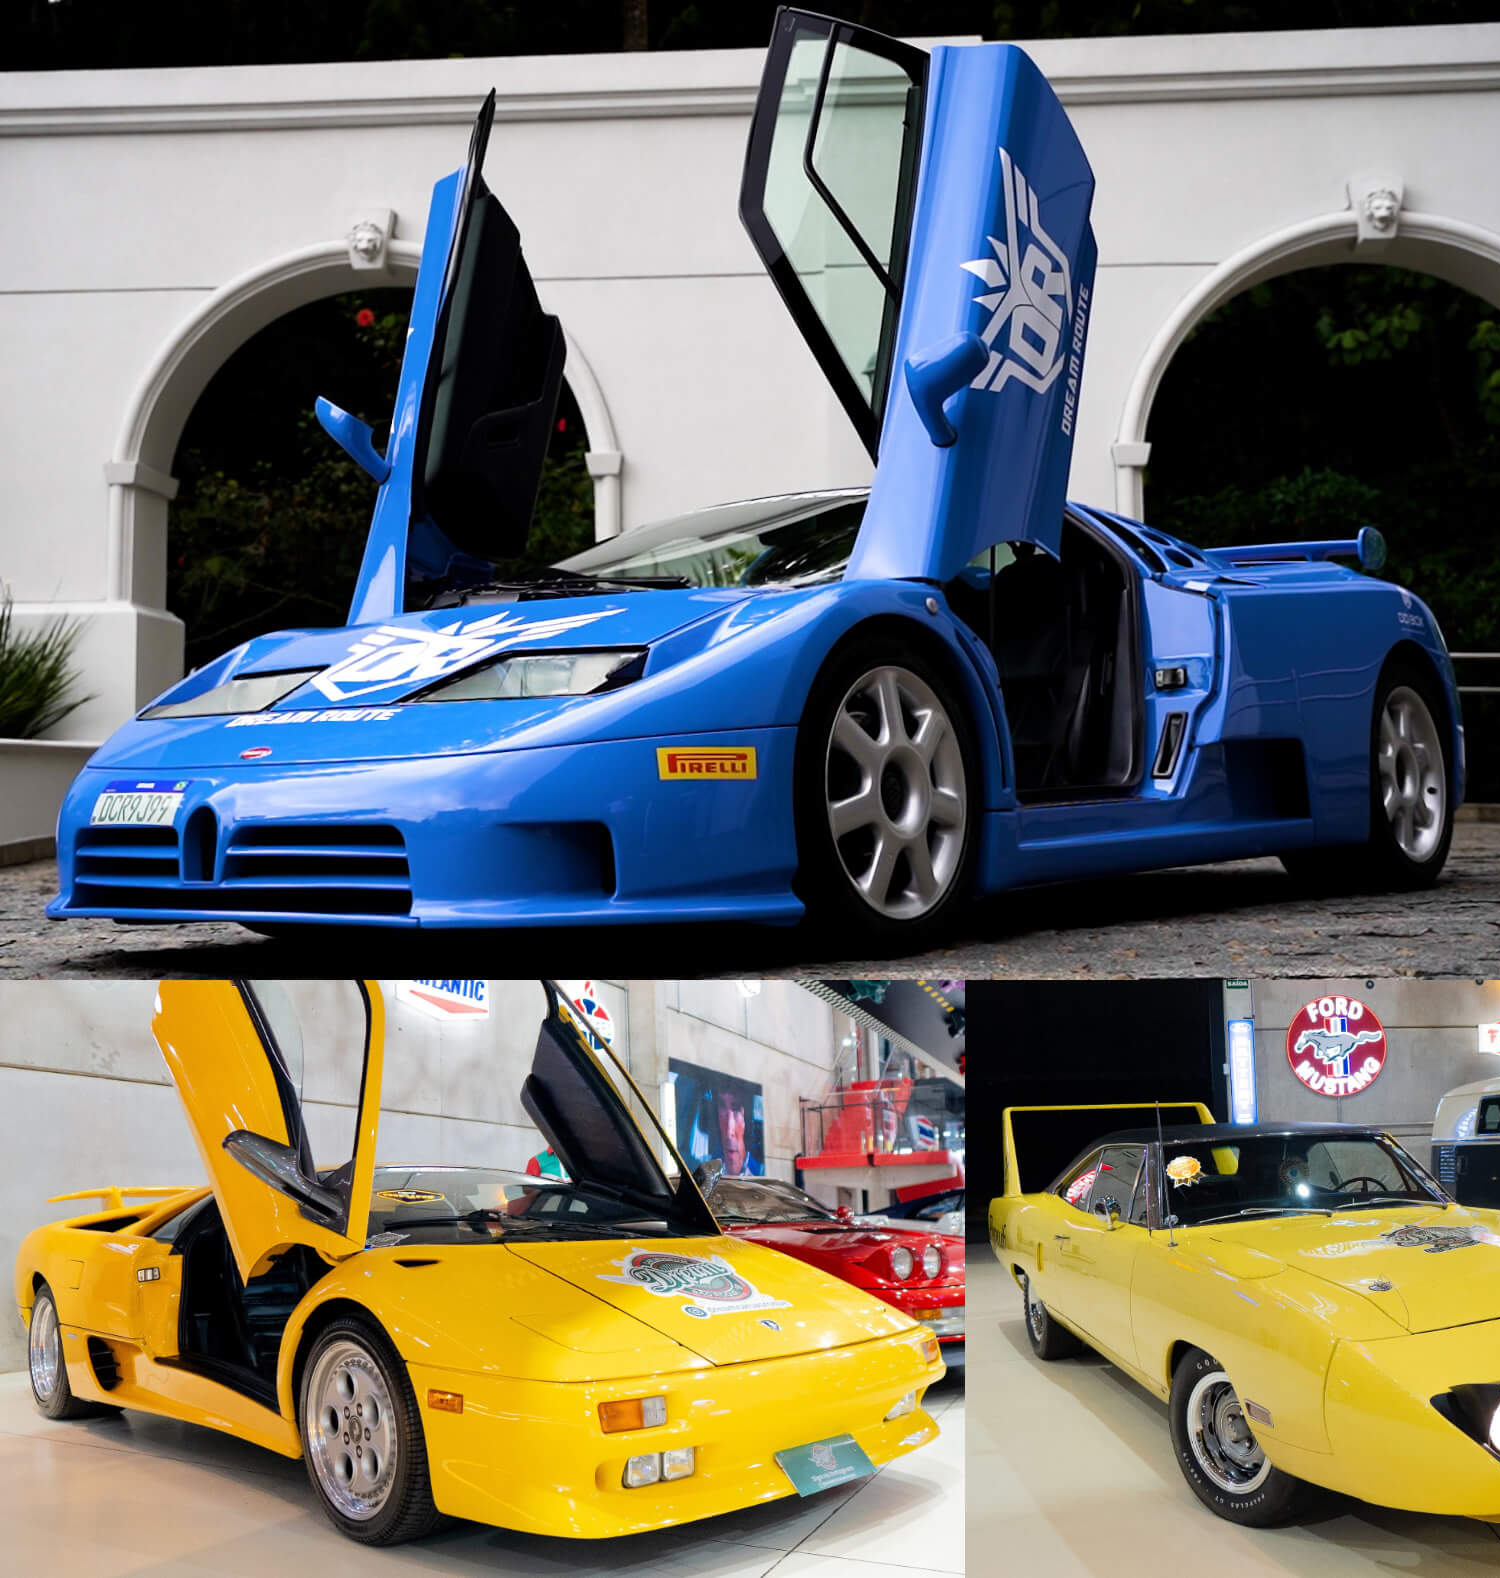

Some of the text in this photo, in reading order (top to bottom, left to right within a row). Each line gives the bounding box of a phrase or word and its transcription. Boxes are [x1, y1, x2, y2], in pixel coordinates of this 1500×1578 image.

[1060, 282, 1090, 437] DREAM ROUTE
[225, 708, 404, 728] DREAM ROUTE
[667, 753, 748, 774] PIRELLI
[1306, 997, 1364, 1023] FORD
[1295, 1057, 1381, 1095] MUSTANG
